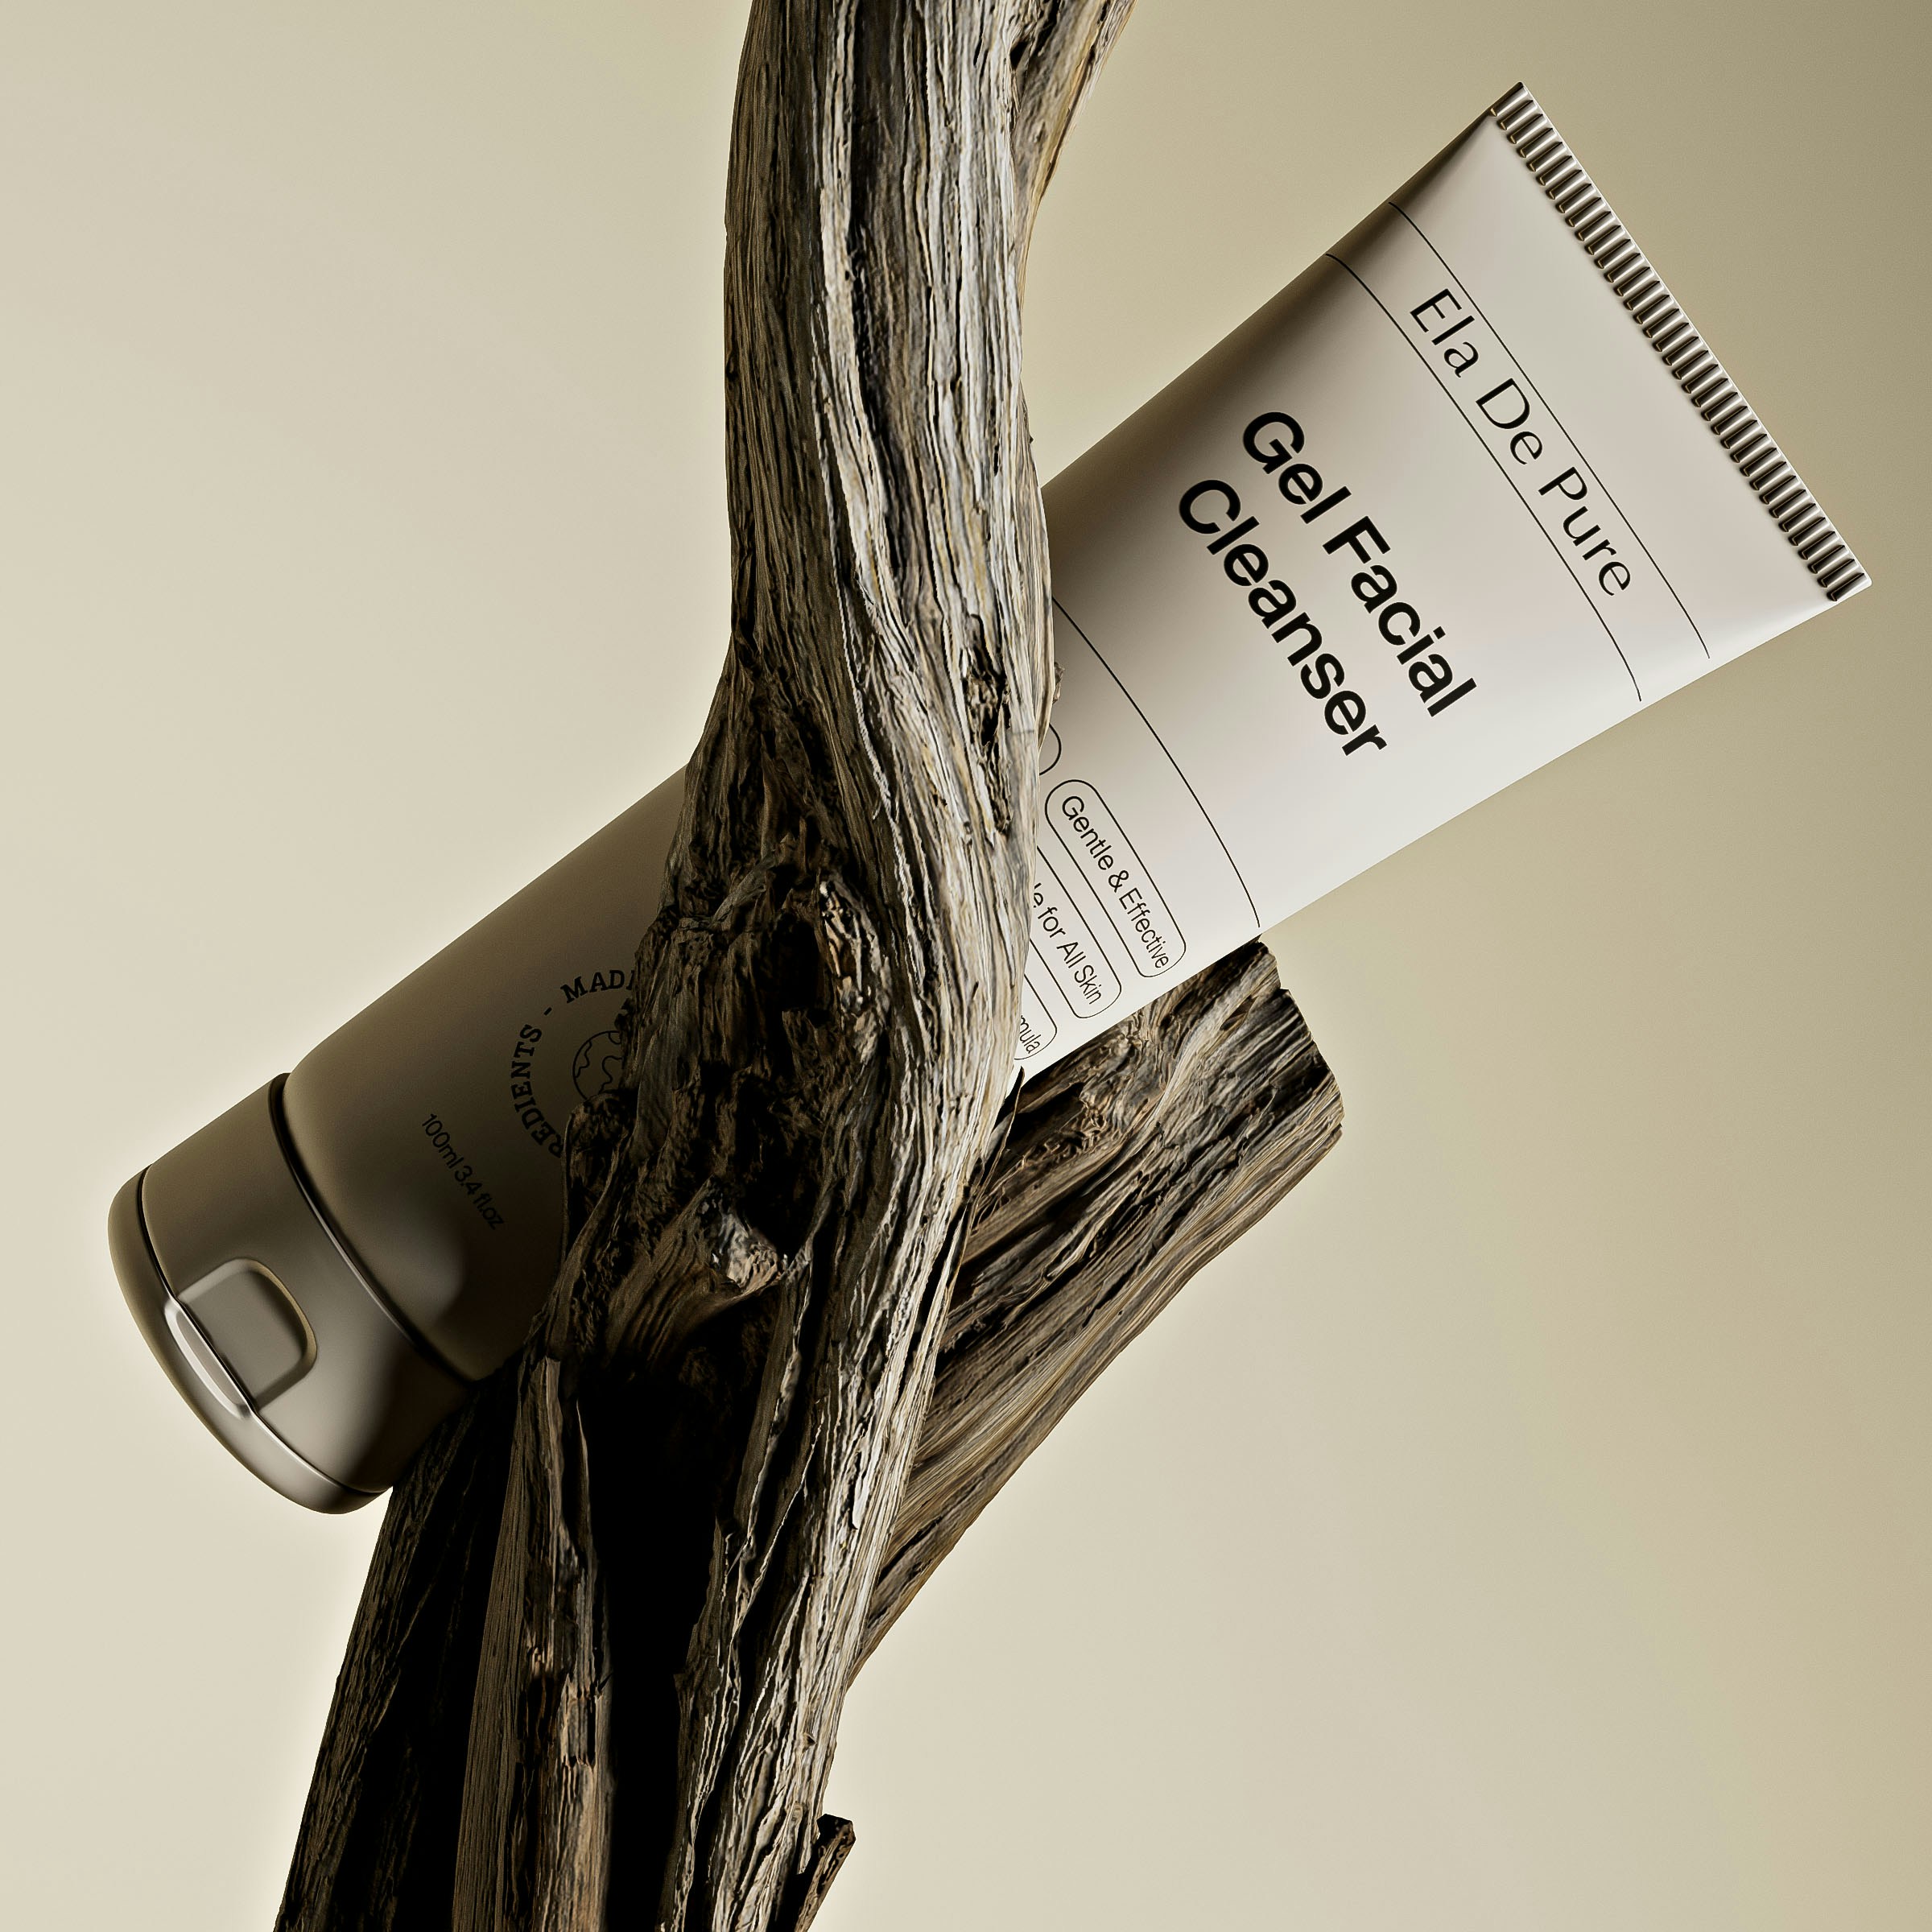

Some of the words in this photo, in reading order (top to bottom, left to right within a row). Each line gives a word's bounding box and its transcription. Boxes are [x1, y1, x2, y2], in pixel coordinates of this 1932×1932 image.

[1410, 289, 1478, 378] Ela
[1476, 378, 1542, 464] De
[1538, 467, 1630, 596] Pure
[1179, 480, 1387, 756] Cleanser
[1242, 411, 1352, 524] Gel
[1323, 516, 1476, 716] Facial
[1038, 907, 1066, 938] for
[1057, 942, 1086, 968] All
[1075, 965, 1101, 1004] Skin
[1063, 796, 1113, 870] Gentle
[1108, 870, 1129, 893] &
[1119, 888, 1168, 968] Effective
[422, 1113, 464, 1169] 100ml
[455, 1166, 482, 1195] 3.4
